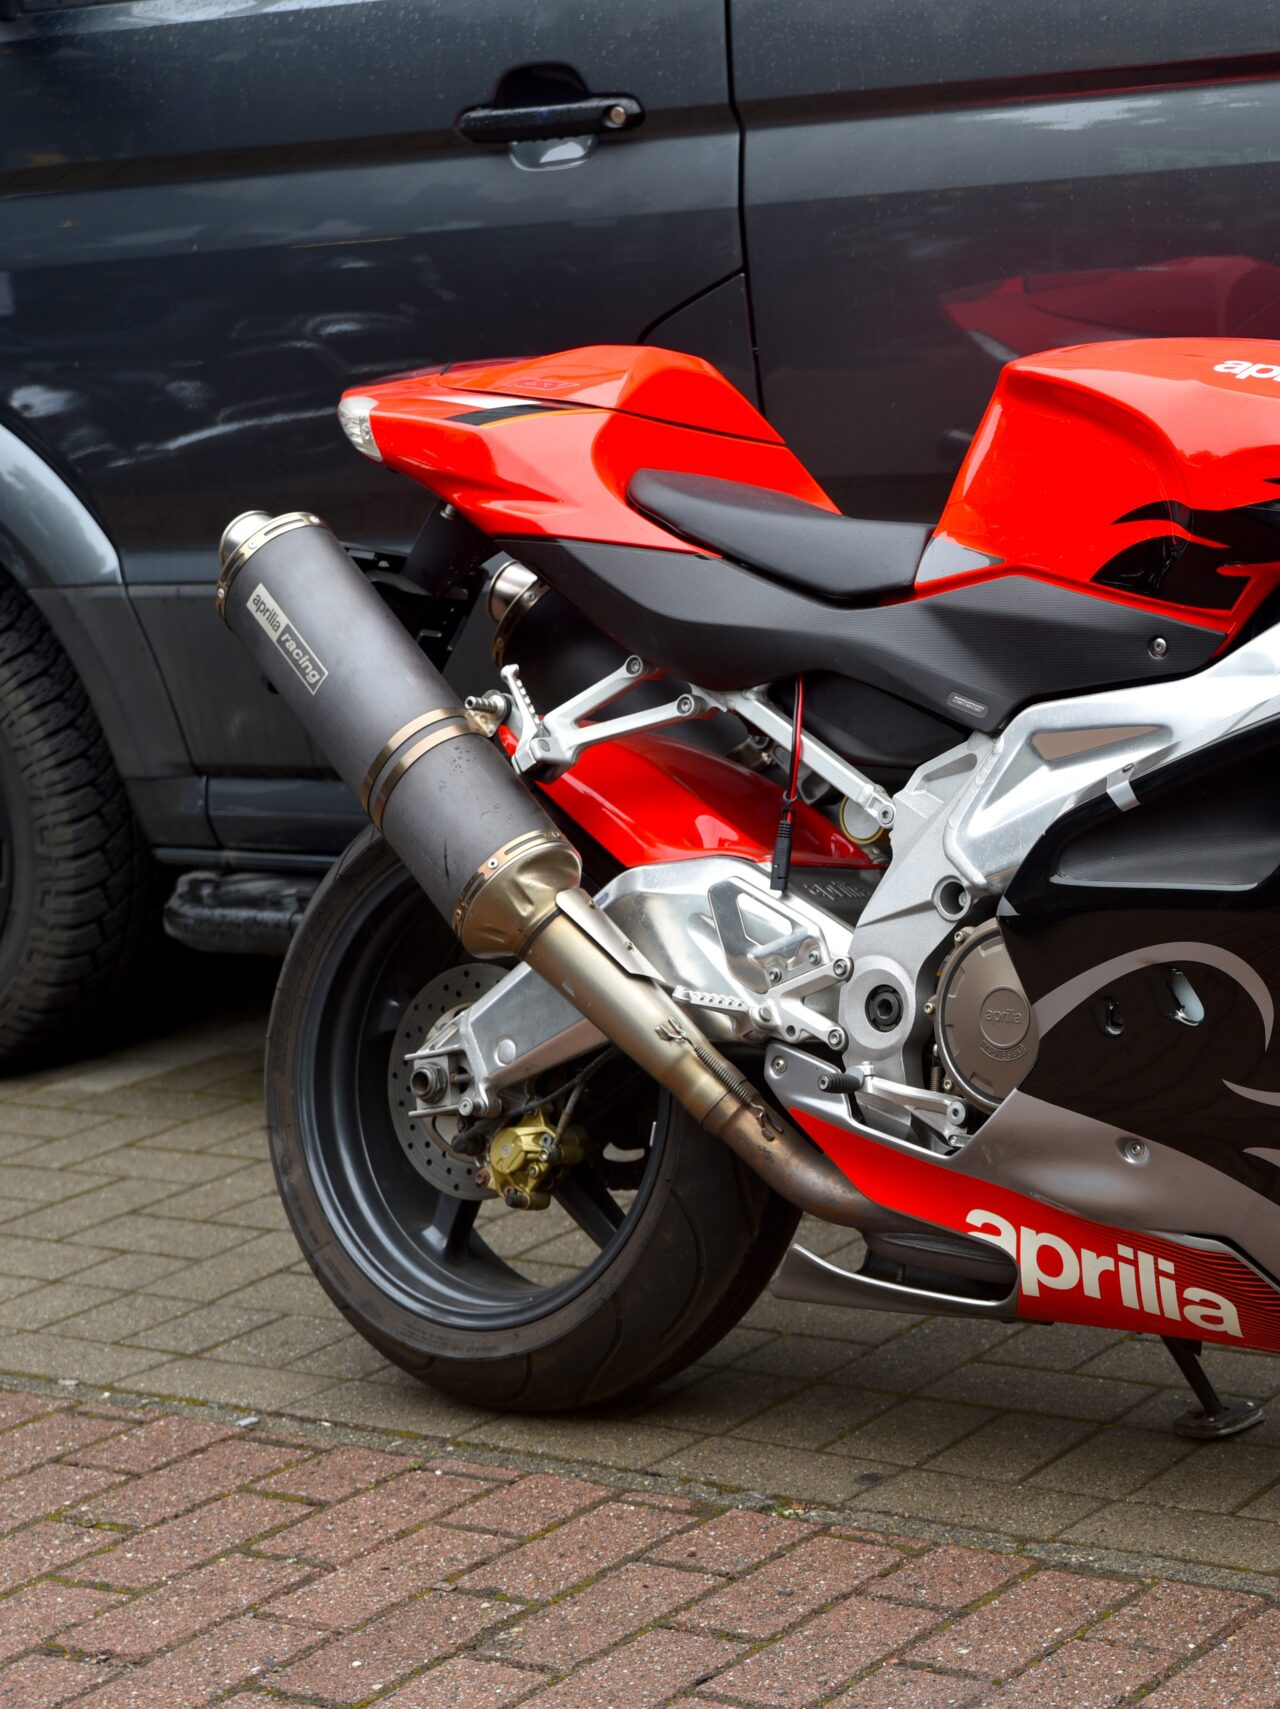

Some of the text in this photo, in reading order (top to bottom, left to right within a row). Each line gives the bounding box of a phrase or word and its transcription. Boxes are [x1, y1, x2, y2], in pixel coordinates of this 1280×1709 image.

[252, 594, 321, 684] aprilia racing
[984, 1008, 1022, 1026] aprilia
[965, 1208, 1243, 1338] aprilia
